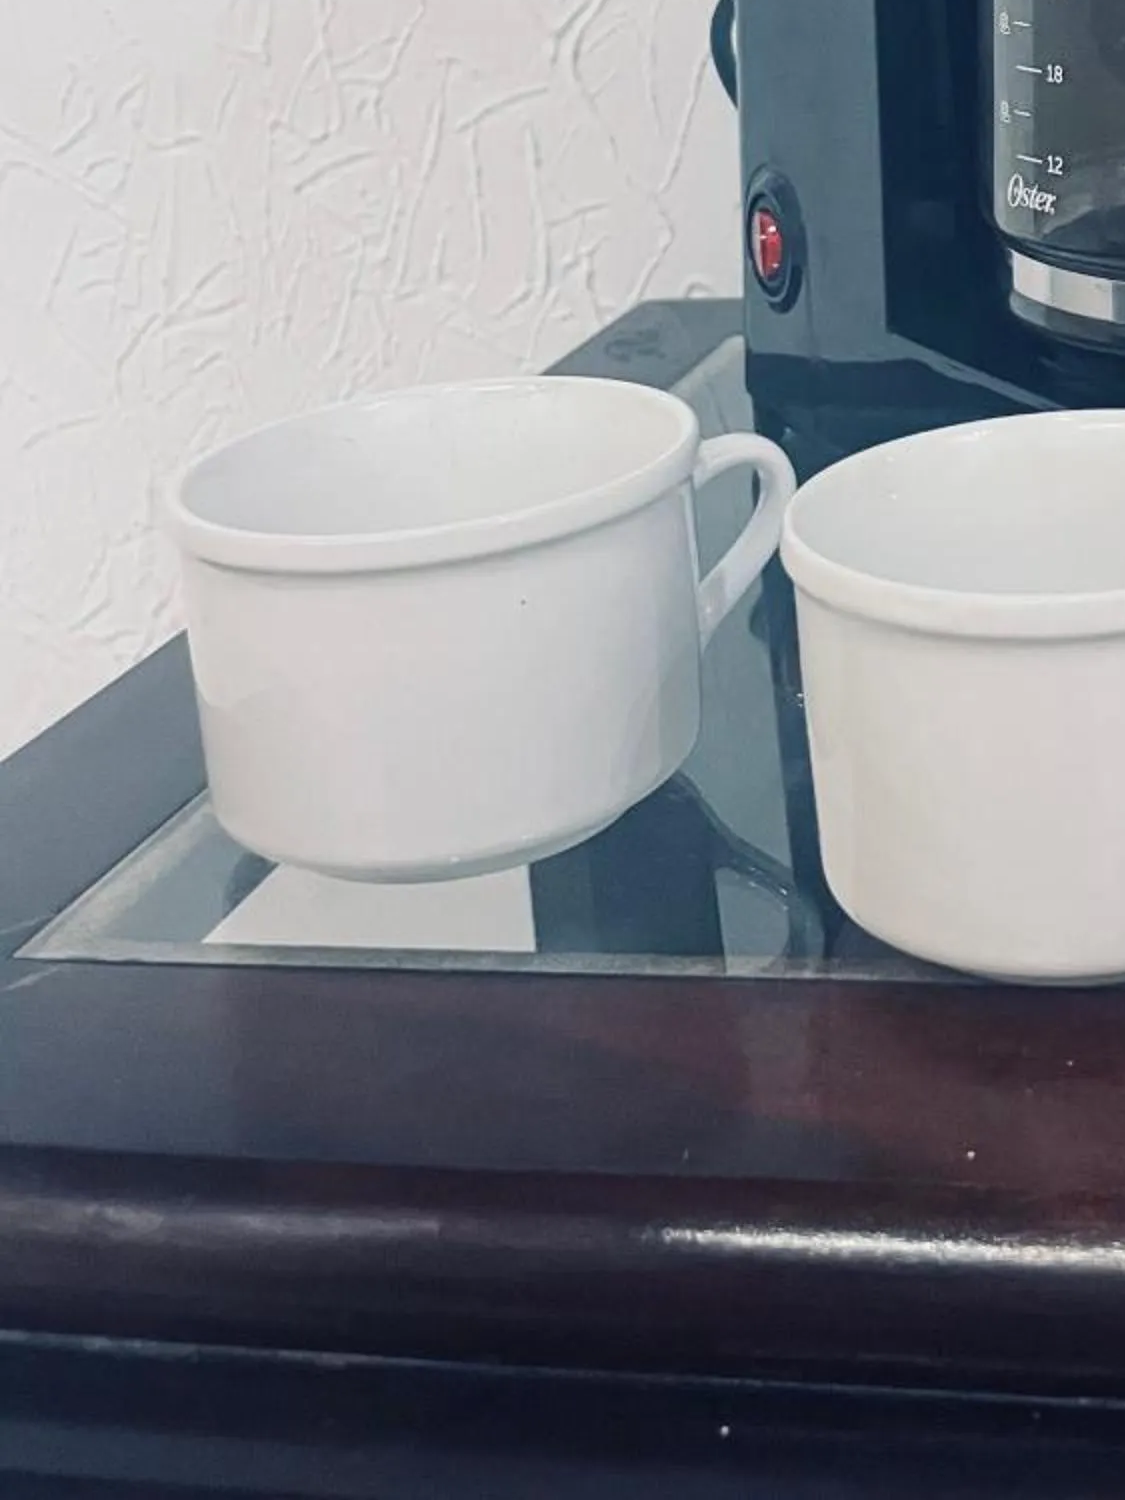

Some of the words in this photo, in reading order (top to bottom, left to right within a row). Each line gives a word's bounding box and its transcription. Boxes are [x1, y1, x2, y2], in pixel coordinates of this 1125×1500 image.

[1046, 63, 1063, 84] 18
[1047, 155, 1063, 175] 12
[1007, 172, 1057, 215] Oster
